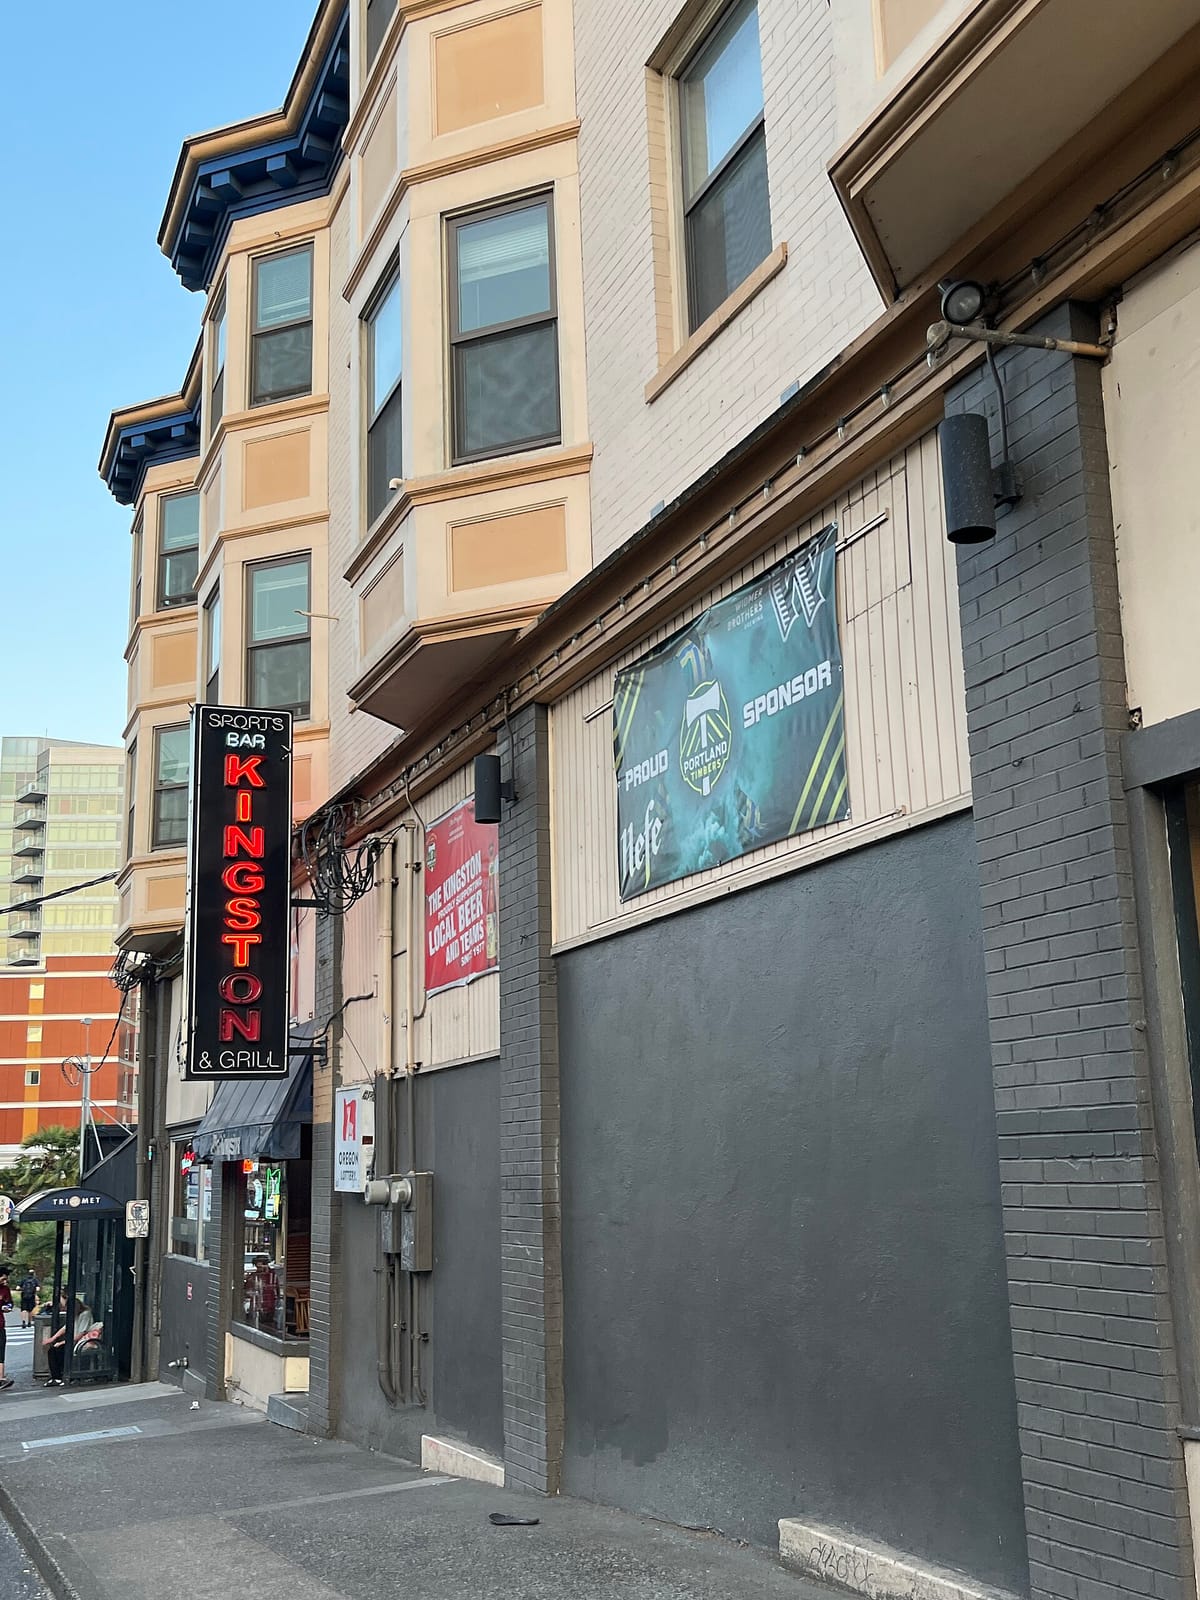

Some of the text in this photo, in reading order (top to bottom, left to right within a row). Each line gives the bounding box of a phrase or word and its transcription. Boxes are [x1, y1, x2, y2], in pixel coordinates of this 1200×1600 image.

[727, 600, 763, 631] BROTHERS
[743, 660, 832, 729] SPONSOR
[208, 713, 284, 732] SPORTS
[226, 732, 265, 750] BAR
[683, 740, 728, 774] PORTLAND
[625, 749, 668, 792] PROUD
[690, 758, 721, 782] TIMBERS
[218, 753, 267, 1042] KINGSTON
[428, 885, 443, 917] THE
[443, 850, 482, 905] KINGSTON
[428, 888, 484, 957] LOCAL BEER
[445, 919, 485, 968] AND TEAMS
[219, 1051, 281, 1069] GRILL
[338, 1151, 359, 1166] OREGON
